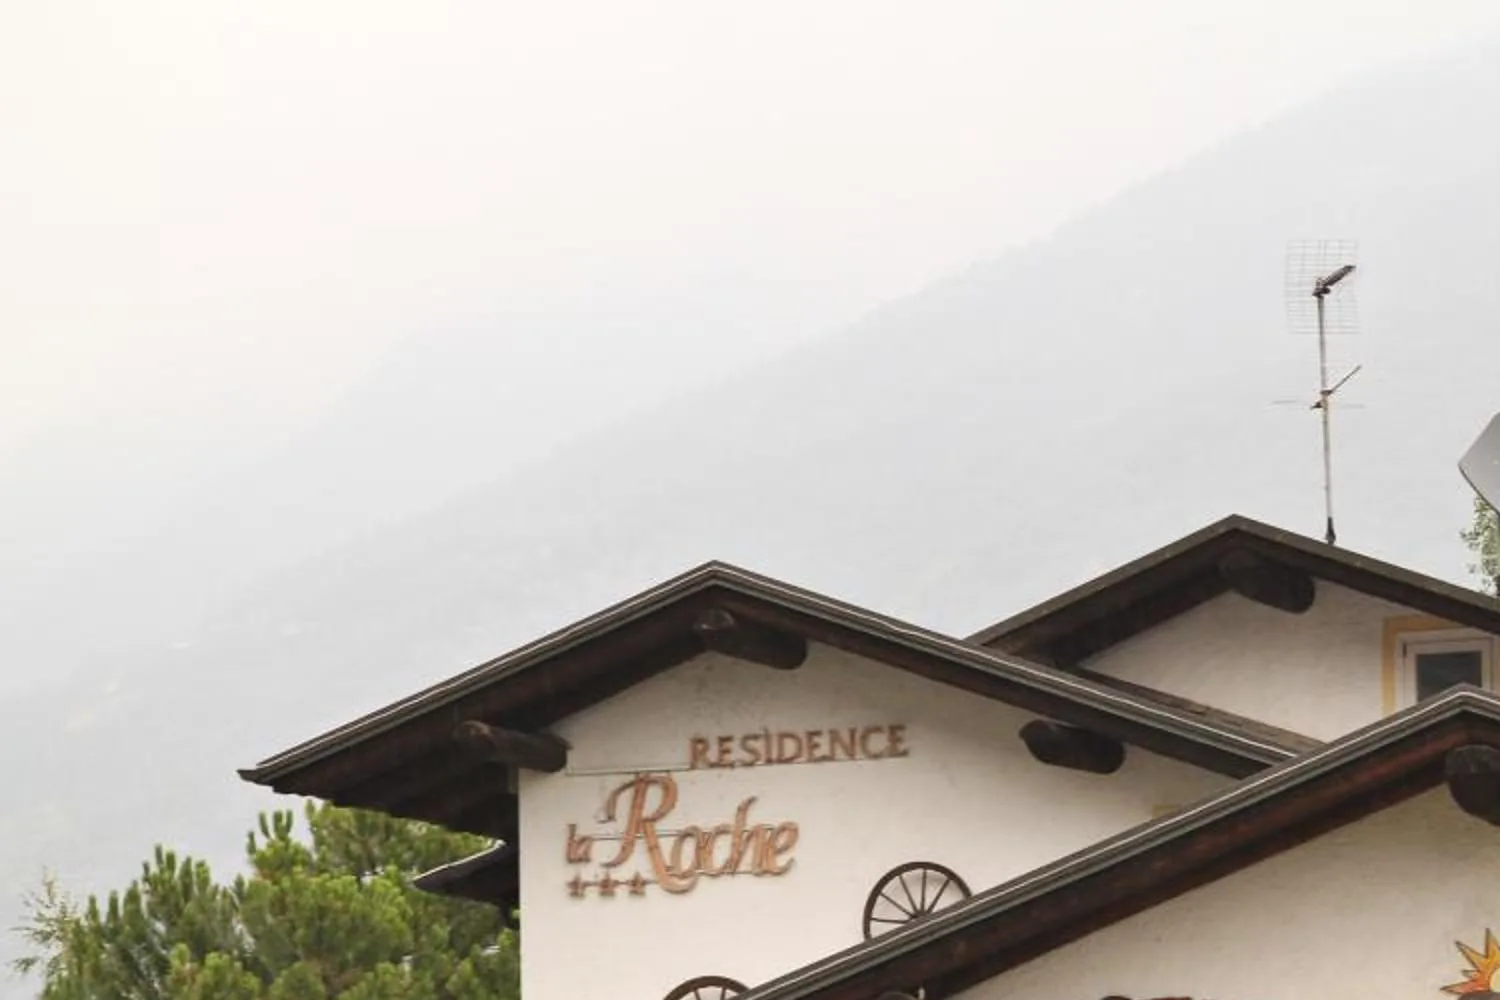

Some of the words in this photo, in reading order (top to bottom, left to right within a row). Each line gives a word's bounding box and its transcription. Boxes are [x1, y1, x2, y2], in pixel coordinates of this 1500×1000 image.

[688, 724, 910, 770] RESIDENCE
[565, 823, 594, 864] la
[598, 771, 799, 893] Roche
